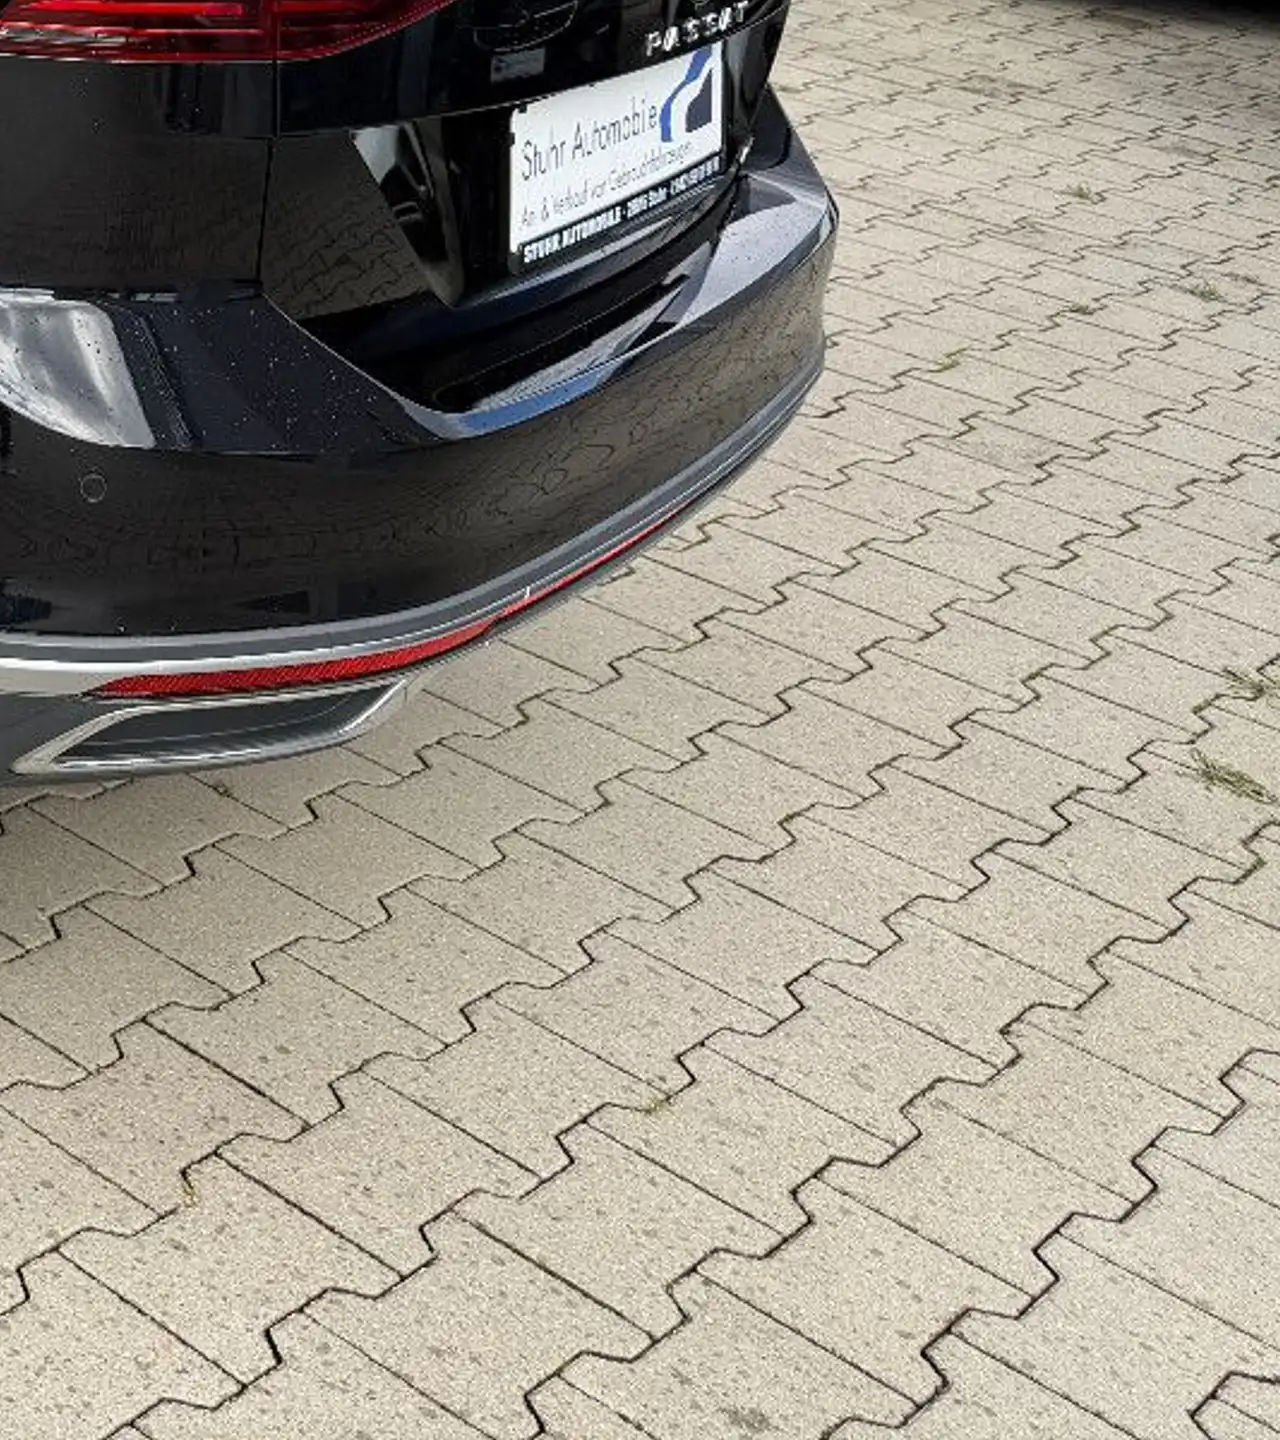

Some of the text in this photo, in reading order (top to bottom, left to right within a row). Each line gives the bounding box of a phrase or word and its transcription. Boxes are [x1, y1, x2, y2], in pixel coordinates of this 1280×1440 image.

[646, 0, 748, 56] PASSAT
[521, 94, 658, 181] Stuhr Automobile
